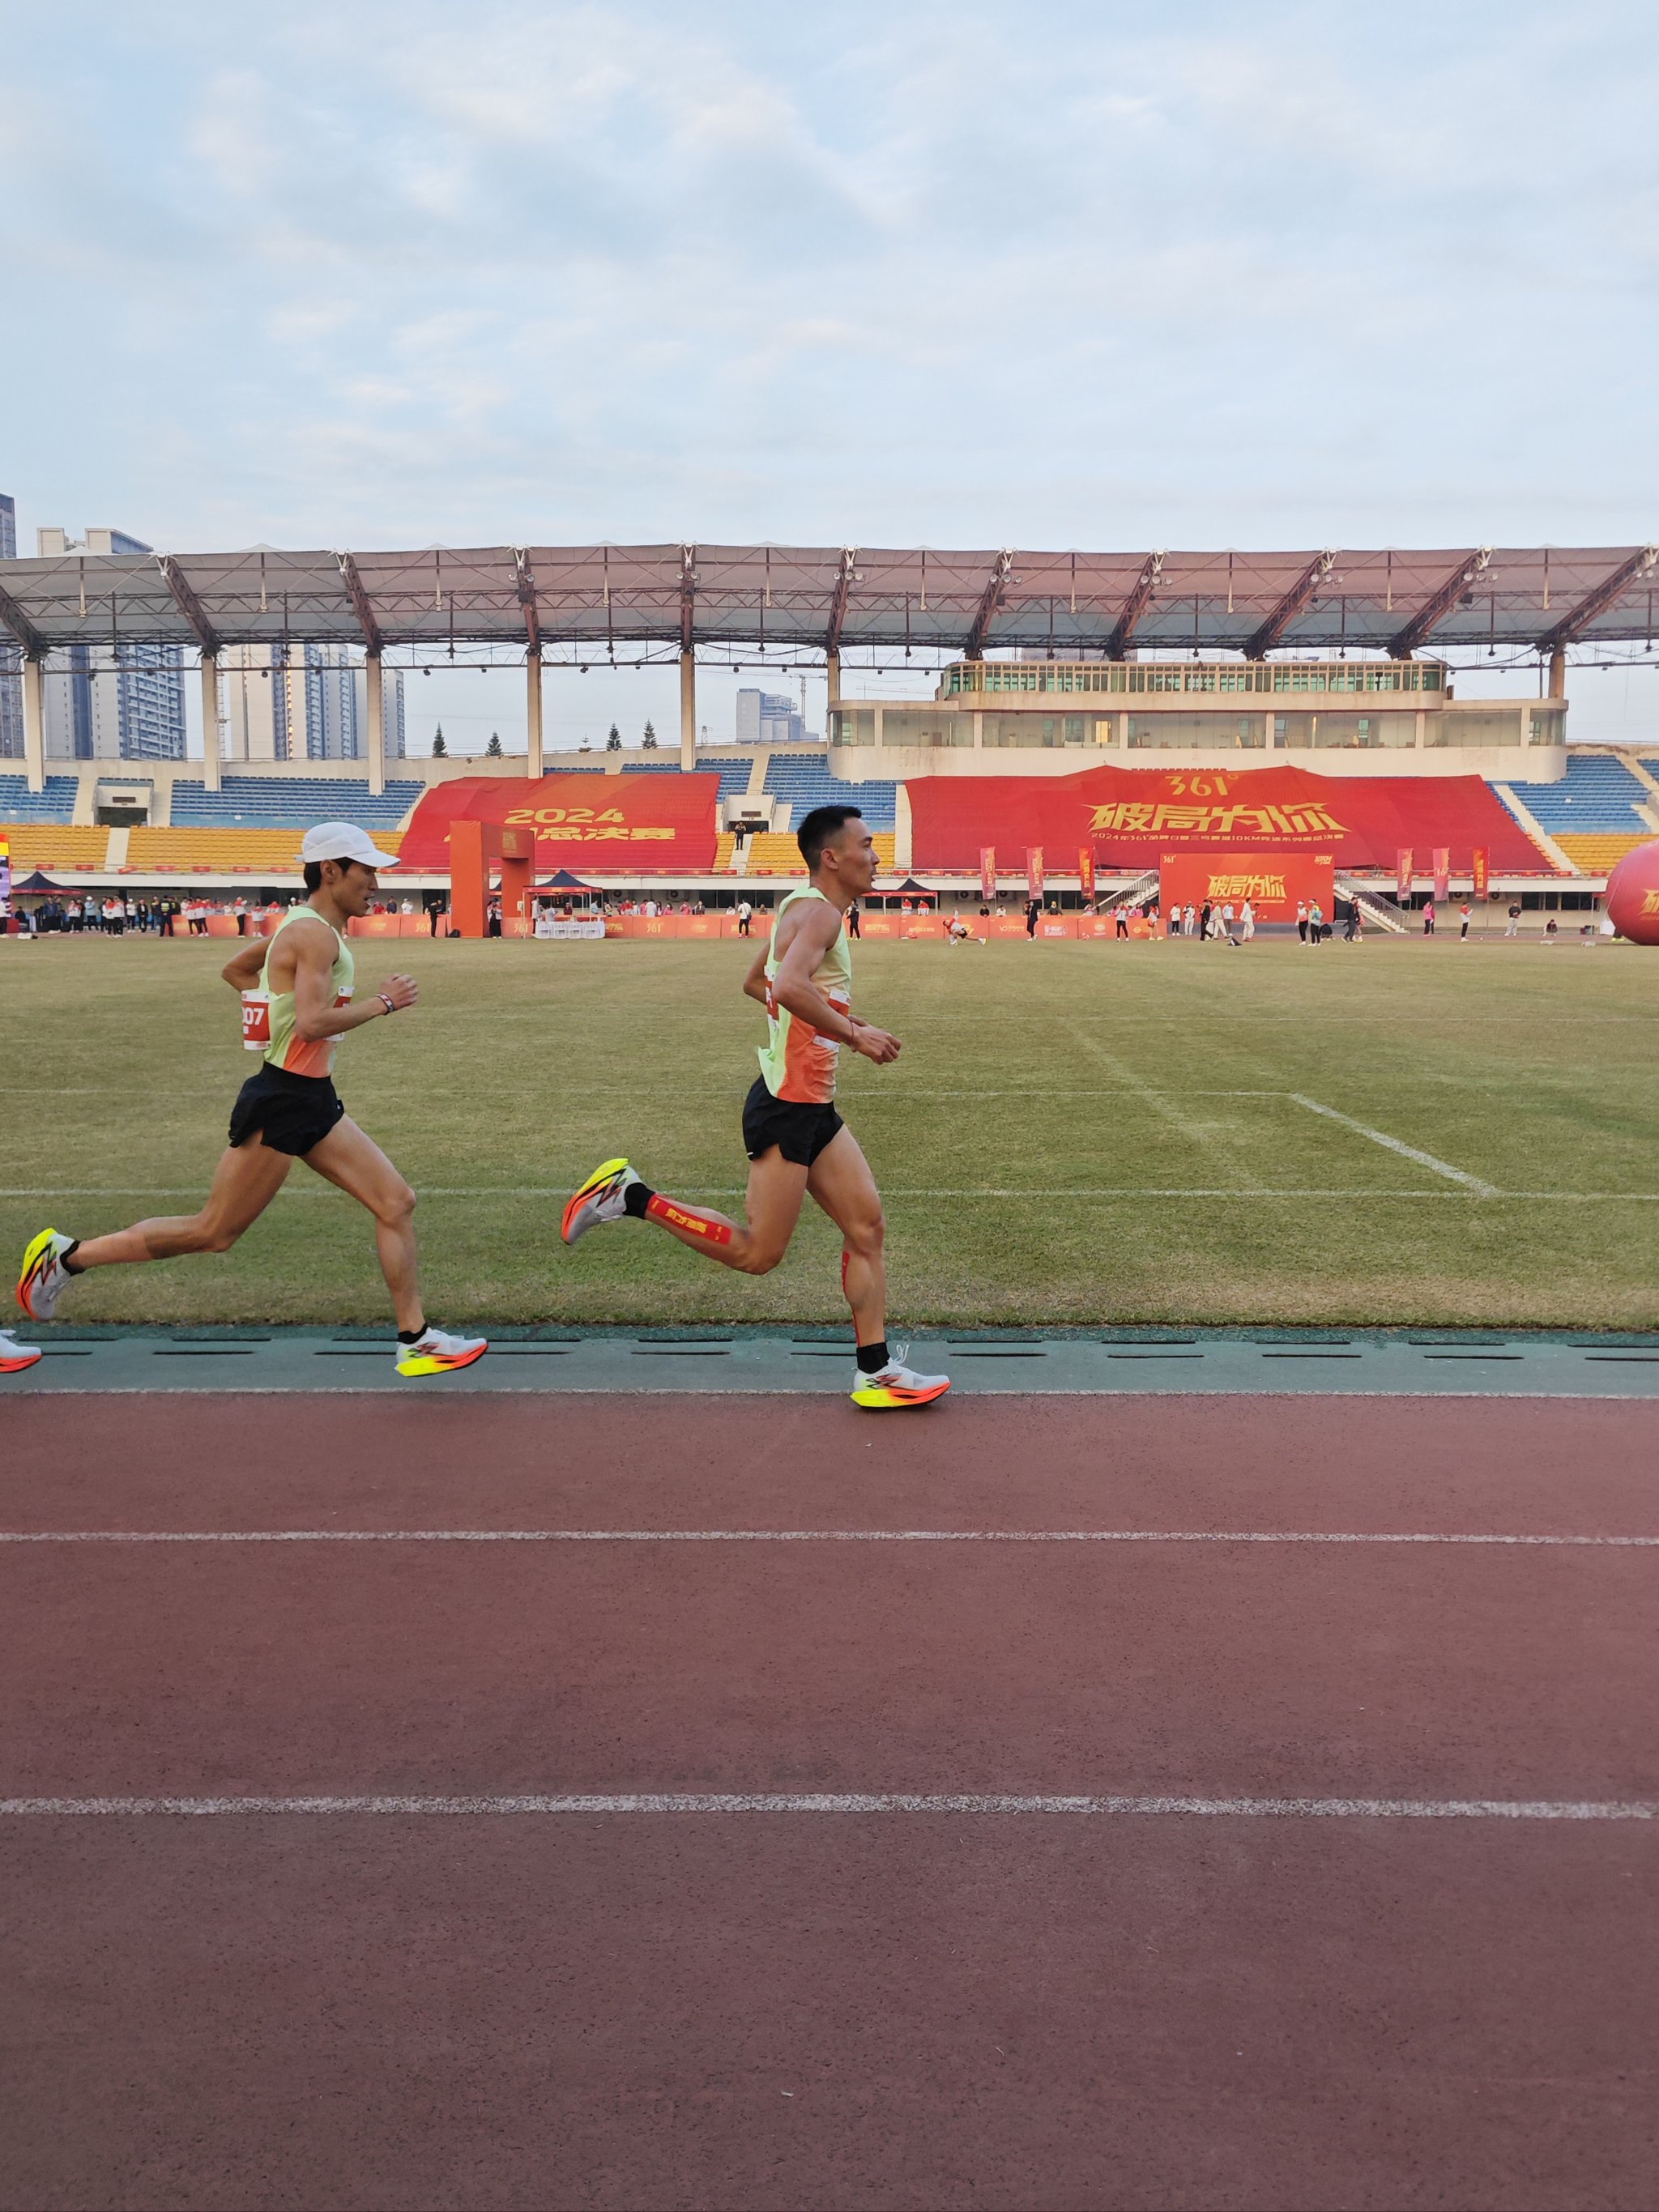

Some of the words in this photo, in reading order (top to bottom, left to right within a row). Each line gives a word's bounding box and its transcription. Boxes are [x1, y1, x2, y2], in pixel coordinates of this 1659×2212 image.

[504, 808, 625, 824] 2024
[1081, 800, 1351, 833] 破局为你
[531, 827, 676, 841] 总决赛
[1206, 874, 1287, 900] 破局为你
[242, 1007, 265, 1025] 07
